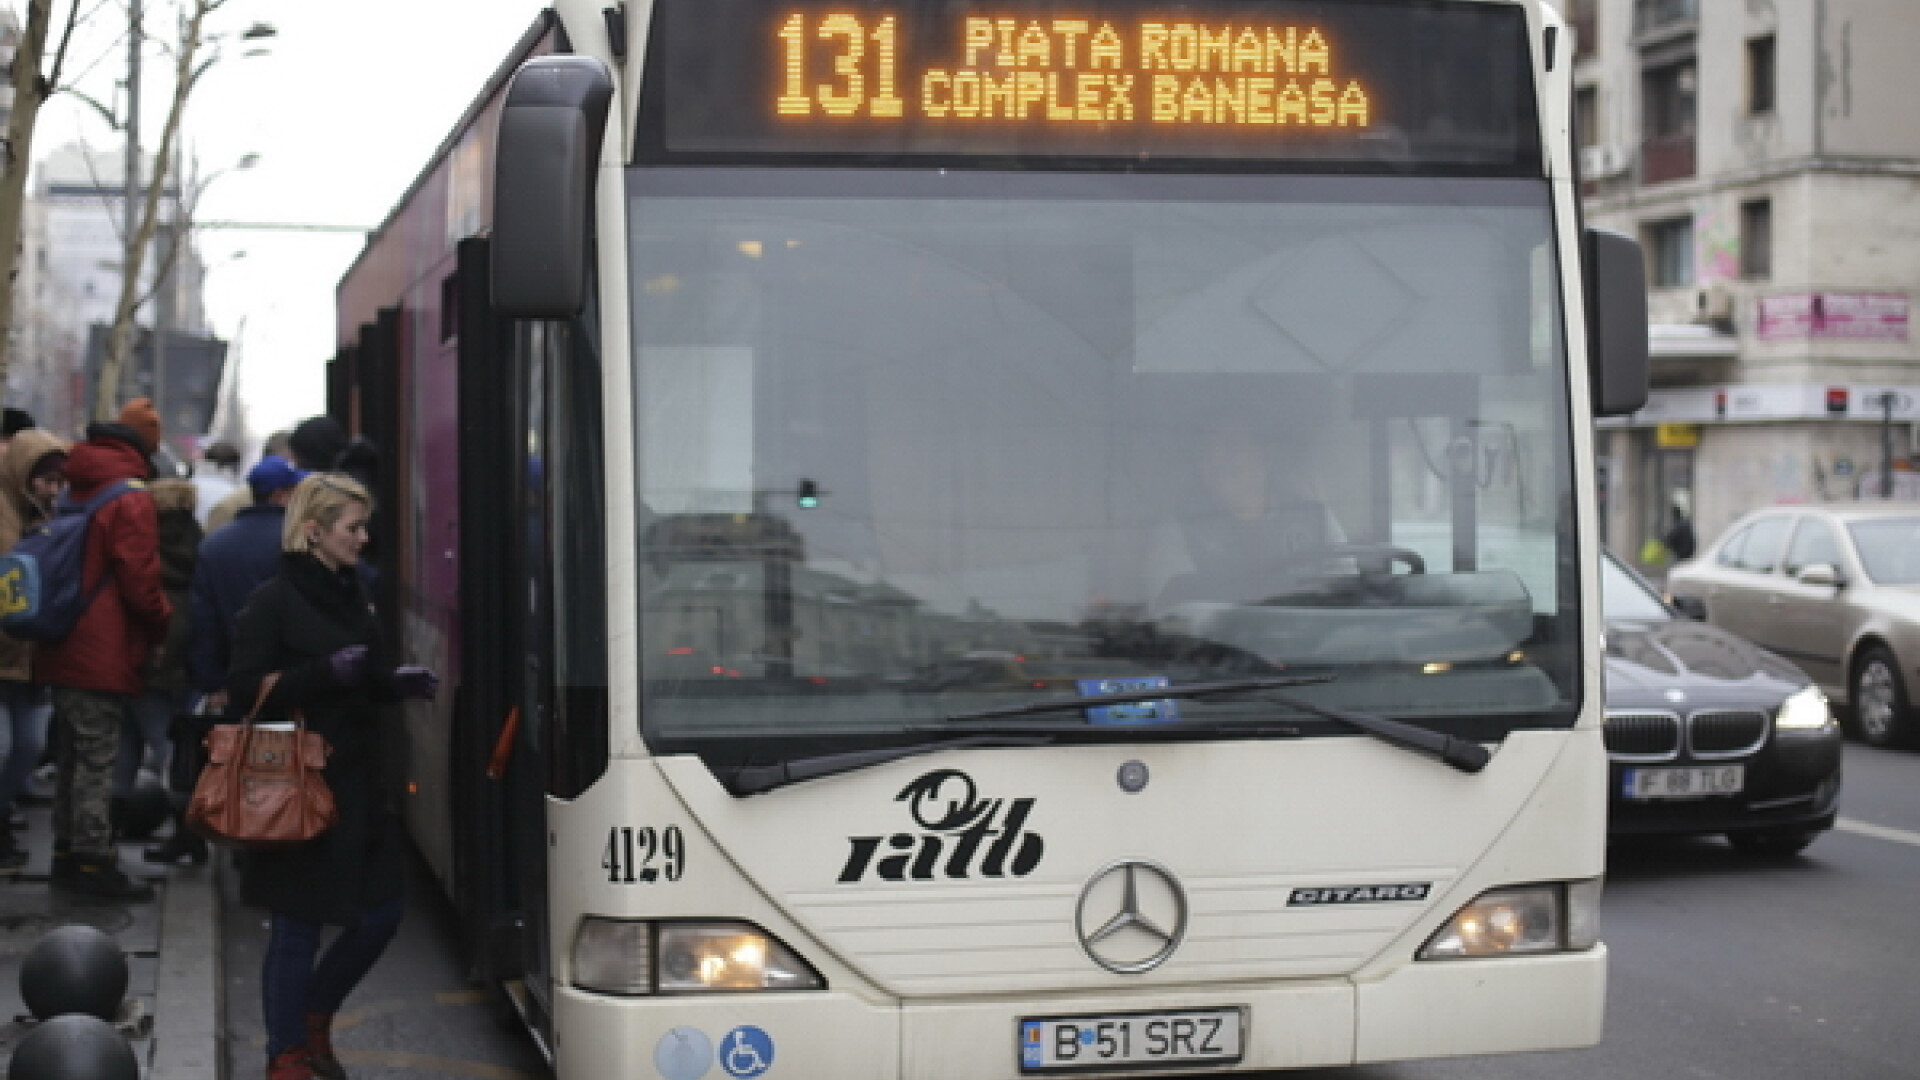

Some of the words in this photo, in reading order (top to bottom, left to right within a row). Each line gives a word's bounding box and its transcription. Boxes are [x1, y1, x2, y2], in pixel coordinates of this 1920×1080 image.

[777, 13, 903, 118] 131
[965, 17, 1122, 69] PIATA
[1141, 22, 1329, 75] ROMANA
[921, 69, 1134, 122] COMPLEX
[1152, 75, 1369, 127] BANEASA
[601, 824, 685, 883] 4129
[1294, 884, 1428, 902] CITARO
[1055, 1024, 1080, 1060] B
[1096, 1021, 1131, 1058] 51
[1145, 1017, 1223, 1055] SRZ
